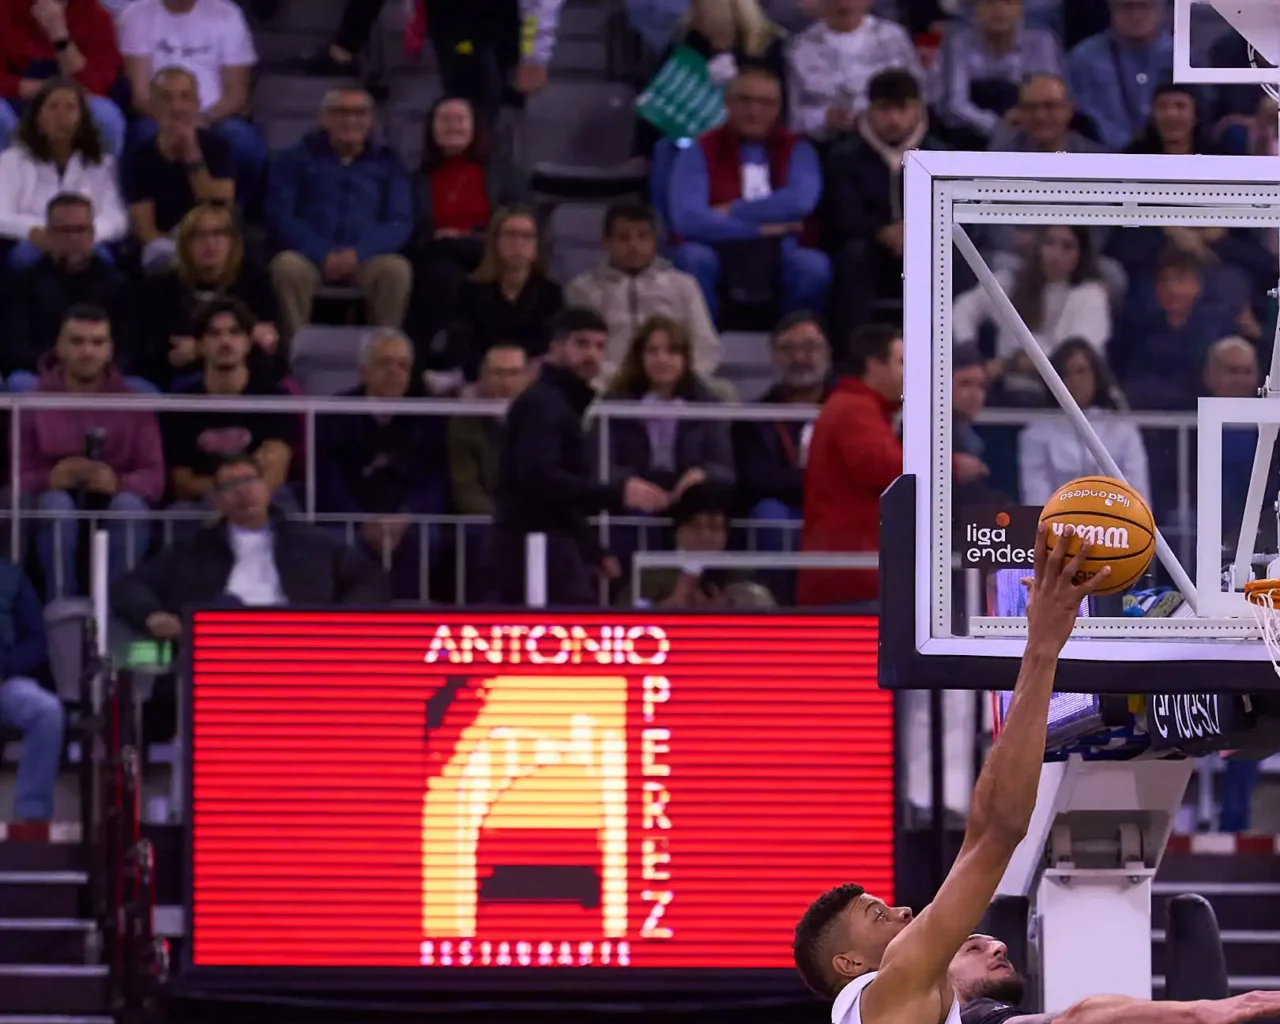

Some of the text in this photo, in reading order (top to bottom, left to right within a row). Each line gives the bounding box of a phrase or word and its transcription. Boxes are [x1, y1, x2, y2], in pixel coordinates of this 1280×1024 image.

[1059, 489, 1107, 502] endesa
[966, 522, 1006, 545] liga
[966, 544, 1036, 563] endes
[424, 624, 670, 664] ANTONIO
[640, 675, 674, 938] PEREZ
